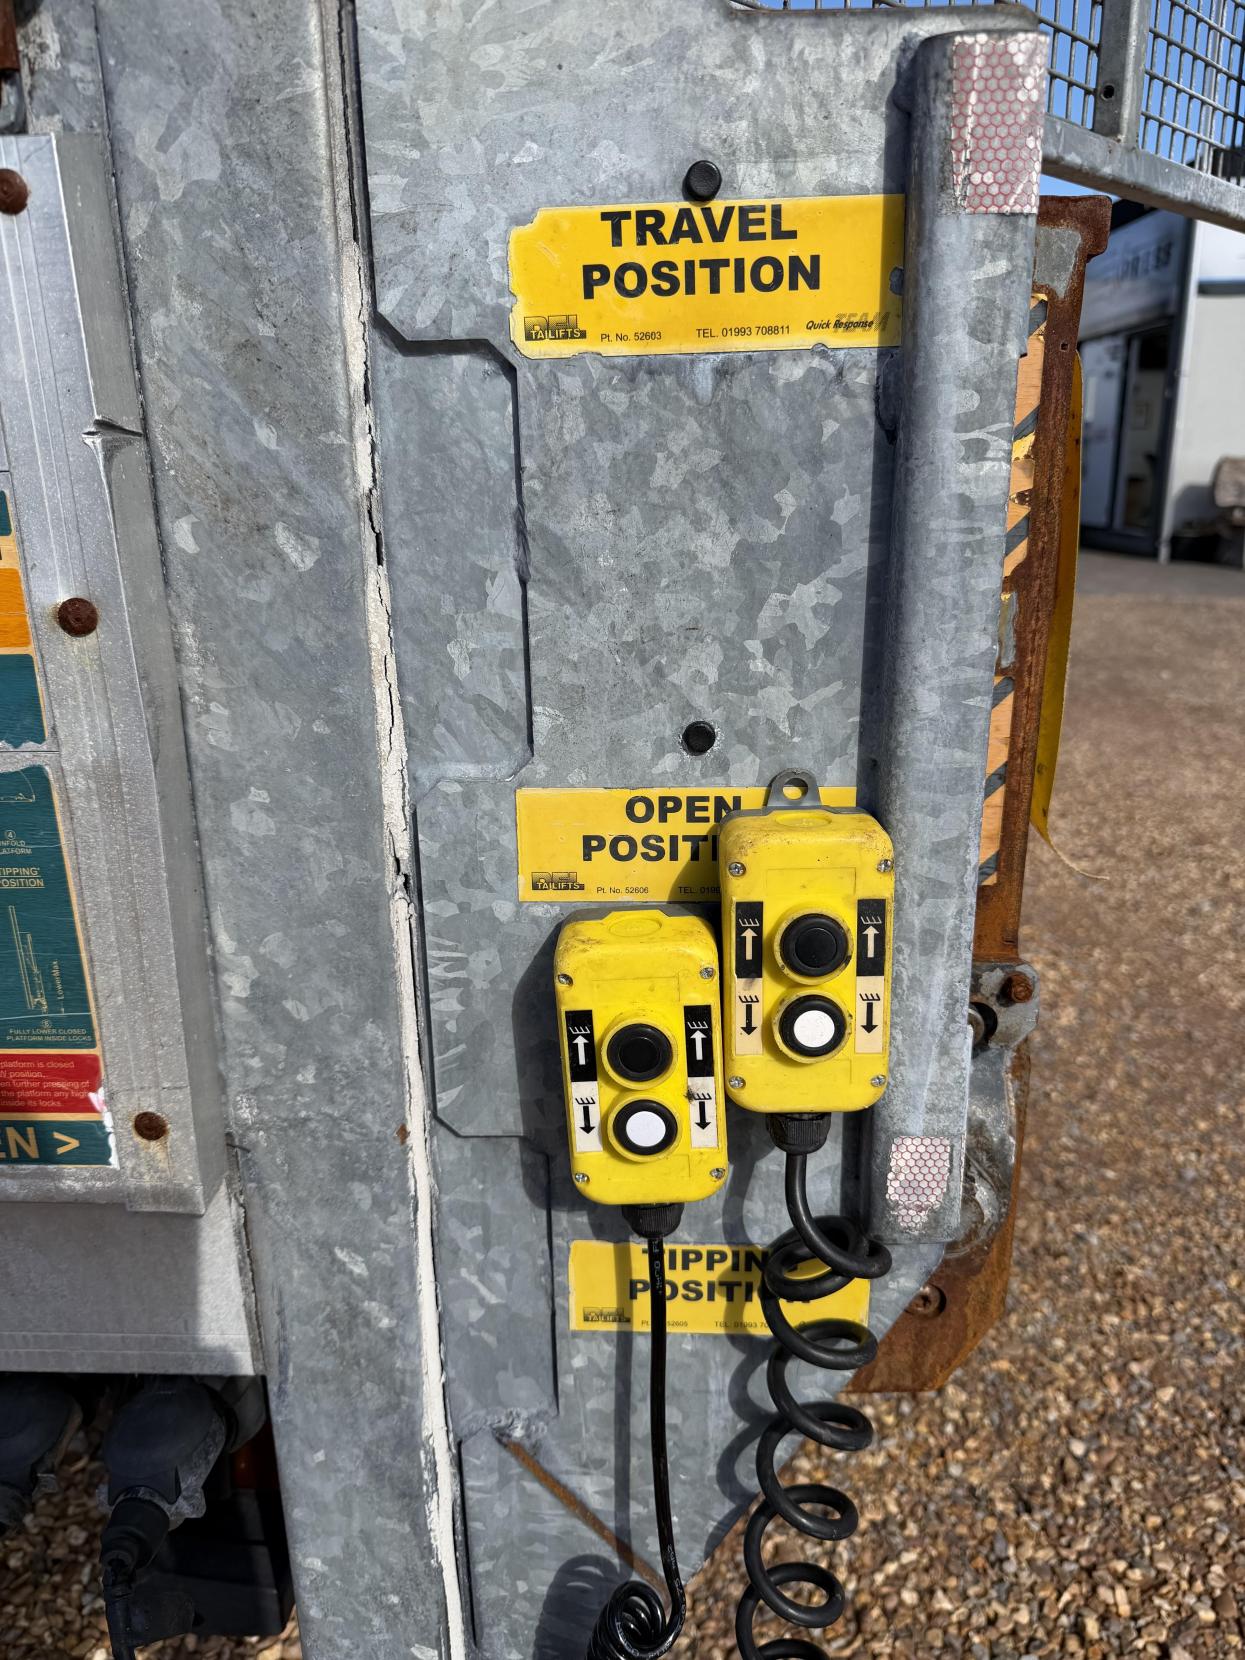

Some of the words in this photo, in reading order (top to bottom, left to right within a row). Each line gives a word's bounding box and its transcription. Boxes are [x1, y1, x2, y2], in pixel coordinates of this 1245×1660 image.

[600, 203, 798, 248] TRAVEL
[582, 254, 822, 300] POSITION
[696, 328, 718, 338] TEL.
[721, 327, 752, 337] 01993
[755, 325, 790, 336] 708811
[805, 319, 831, 330] Quick
[832, 319, 874, 331] Response
[530, 328, 581, 340] TAILIFTS
[600, 333, 612, 343] Pt.
[615, 333, 631, 342] No.
[634, 331, 662, 341] 52603
[625, 795, 742, 823] OPEN
[582, 834, 719, 862] POSITI
[0, 879, 44, 887] OSITION
[536, 882, 580, 890] TAILIFTS
[609, 886, 622, 894] No.
[625, 886, 649, 894] 52606
[700, 886, 720, 894] 0199
[0, 1127, 40, 1159] N
[642, 1248, 798, 1272] IPPIN
[629, 1278, 810, 1303] POSITI
